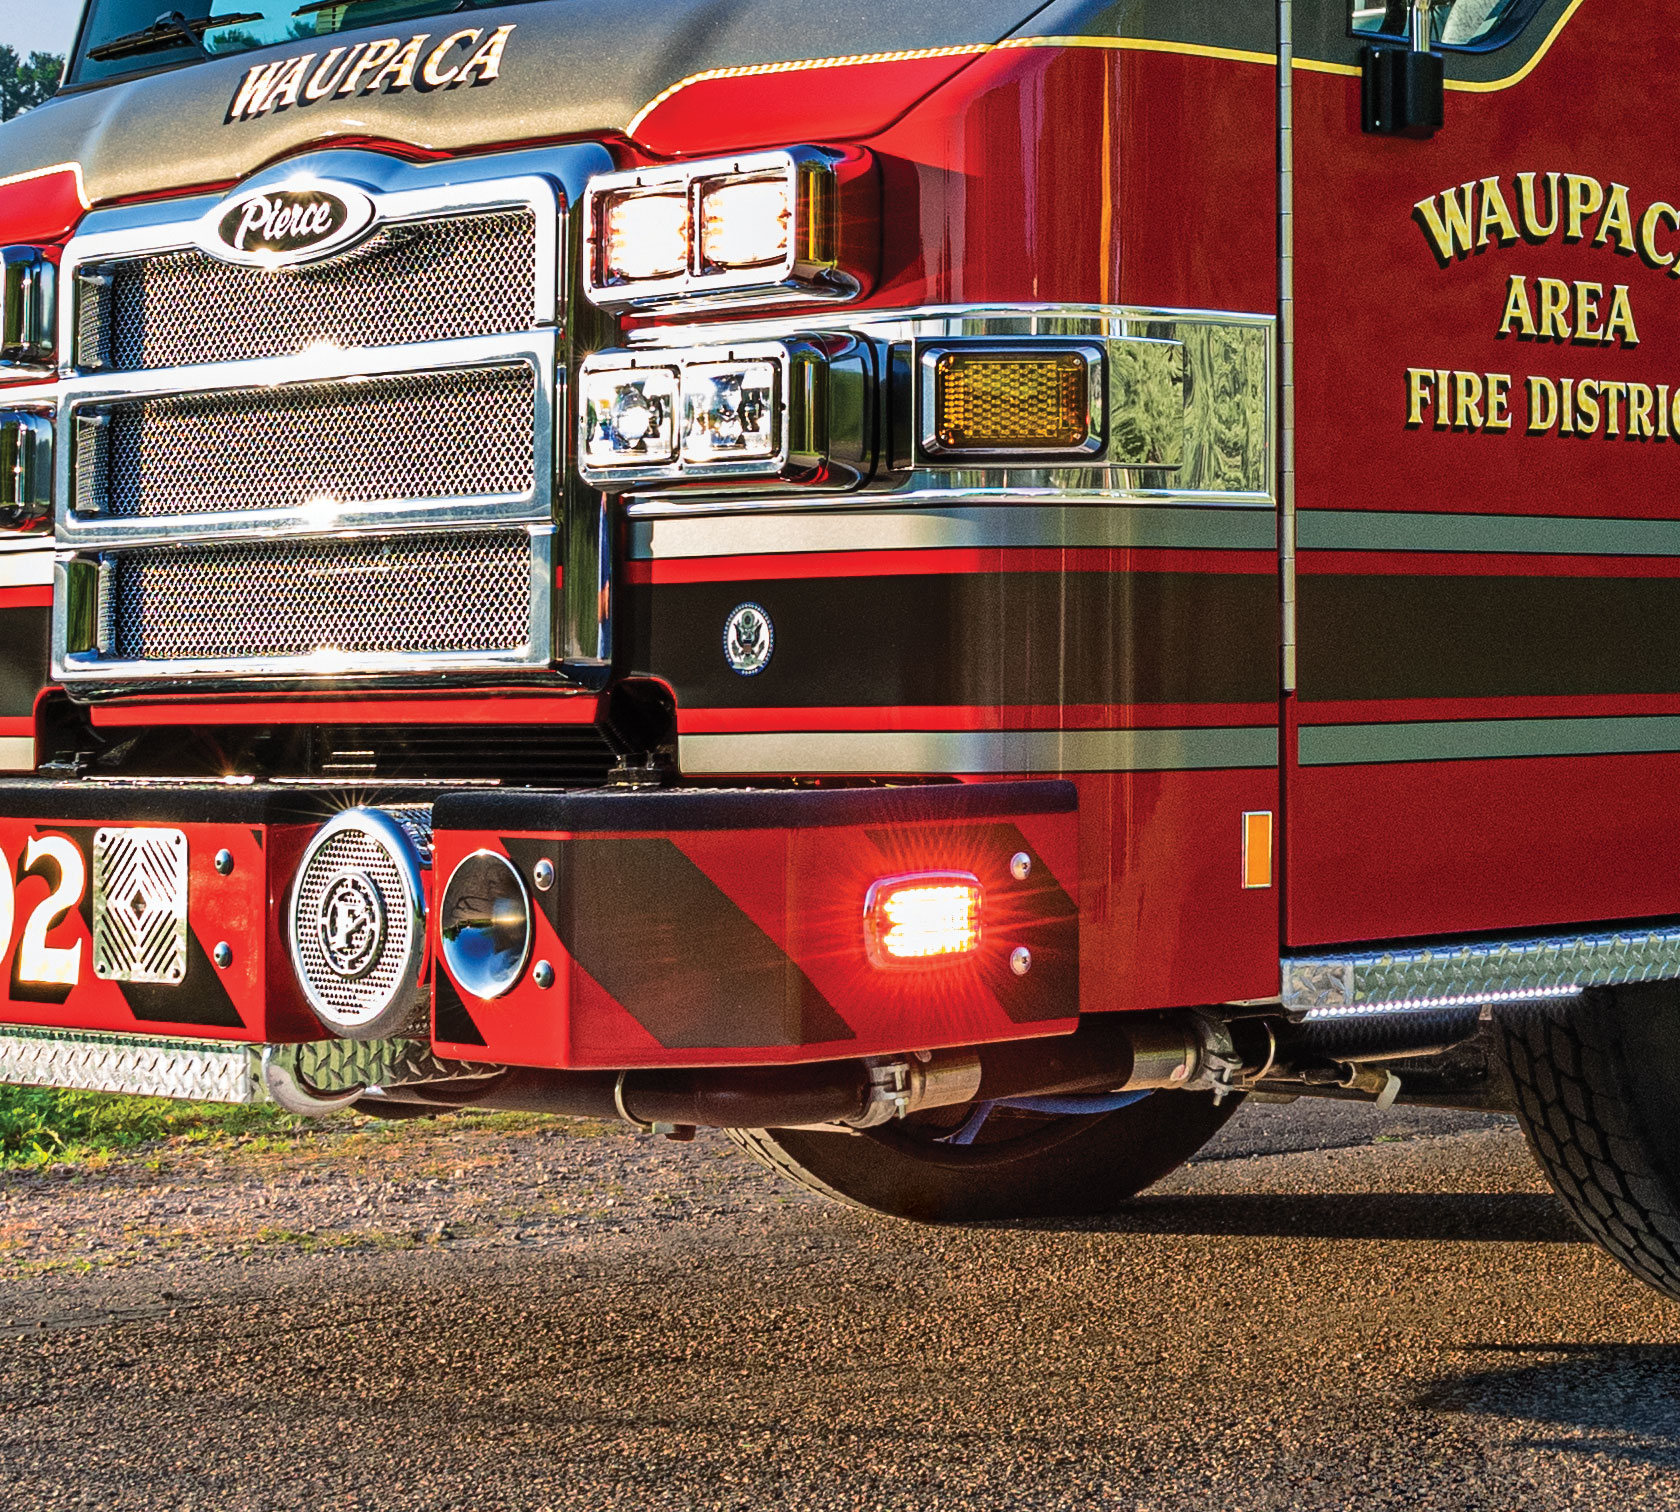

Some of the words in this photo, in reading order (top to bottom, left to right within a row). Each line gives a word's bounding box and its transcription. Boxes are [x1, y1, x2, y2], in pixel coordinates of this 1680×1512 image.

[228, 25, 517, 119] WAUPACA
[234, 194, 333, 250] Pierce
[1498, 274, 1640, 344] AREA
[1406, 367, 1512, 429] FIRE
